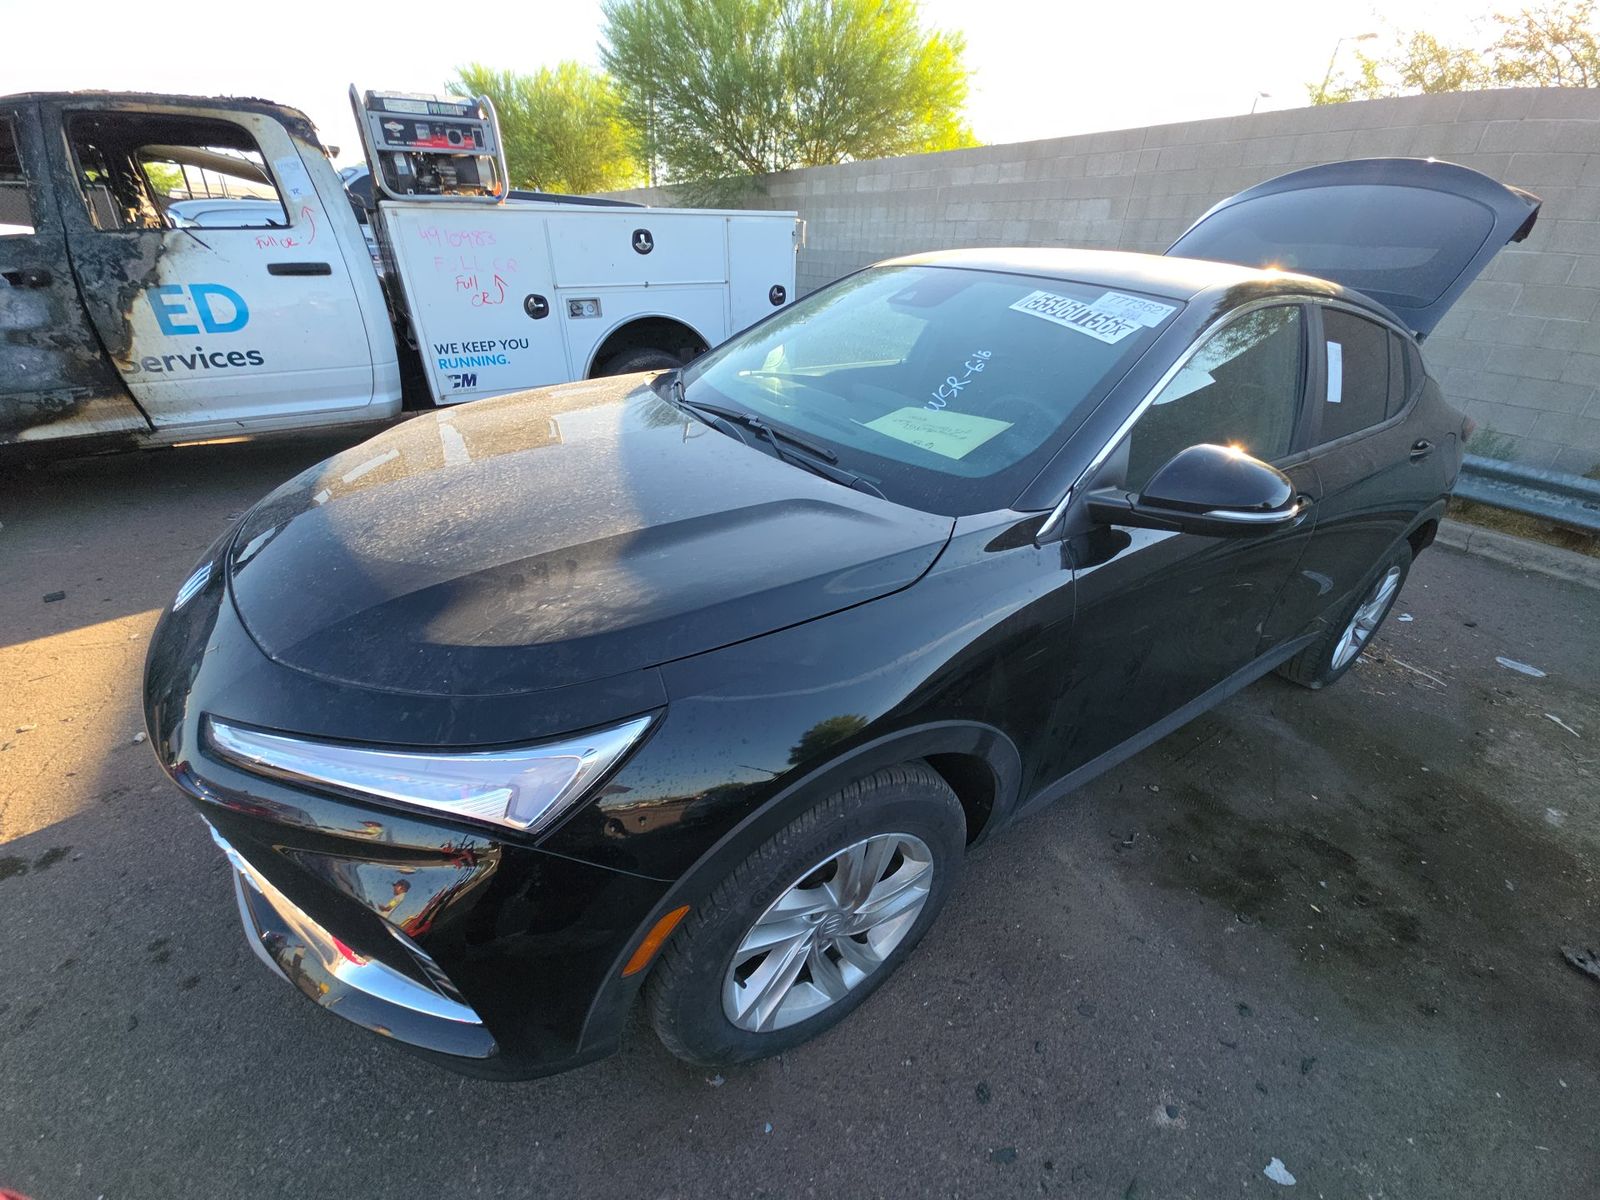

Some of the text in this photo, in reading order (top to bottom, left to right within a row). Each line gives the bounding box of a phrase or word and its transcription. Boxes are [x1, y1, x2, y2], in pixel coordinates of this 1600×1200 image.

[434, 338, 529, 355] WE KEEP YOU
[438, 354, 511, 370] RUNNING.
